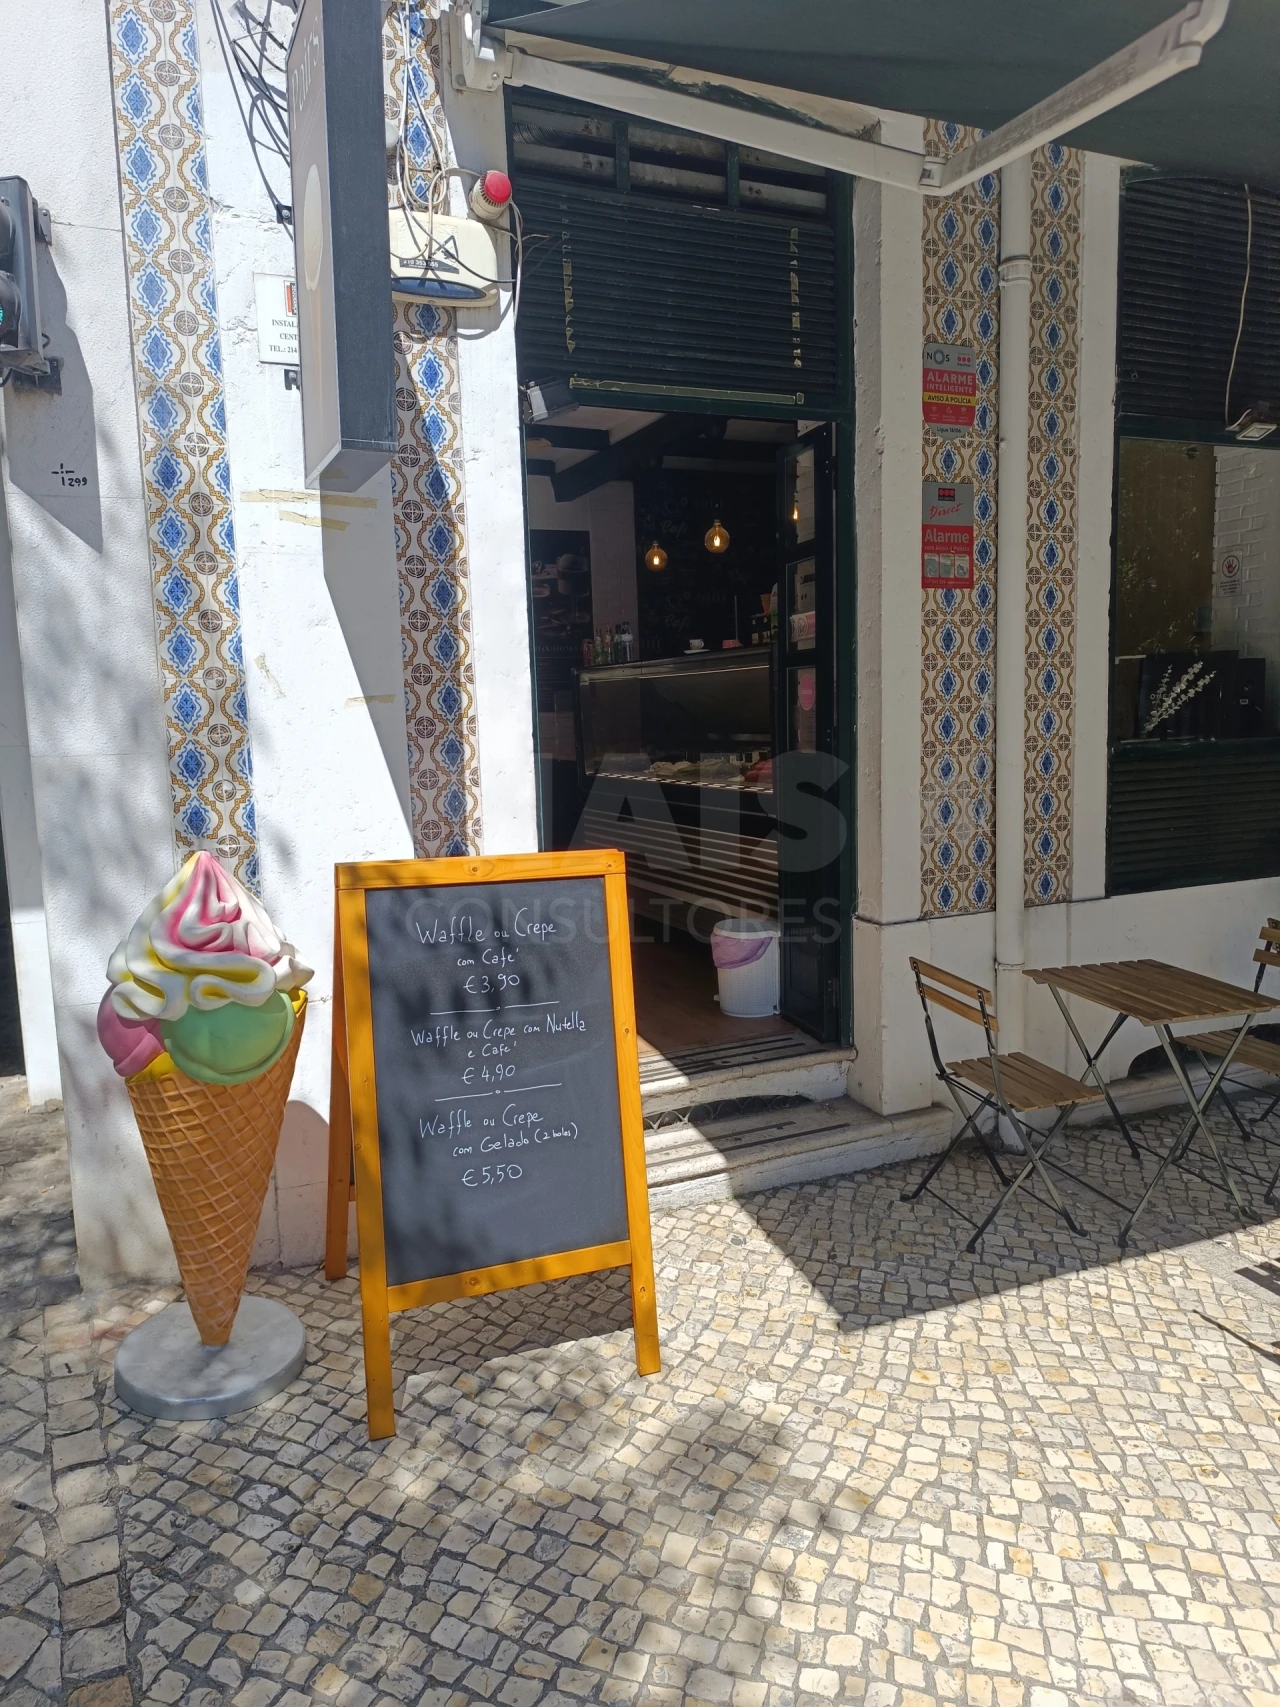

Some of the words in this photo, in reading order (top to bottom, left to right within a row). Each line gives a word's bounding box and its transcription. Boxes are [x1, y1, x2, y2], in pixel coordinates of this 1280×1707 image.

[271, 319, 299, 328] INSTAL
[926, 349, 950, 365] NOS
[926, 371, 973, 386] ALARME
[926, 383, 973, 394] INTELIGENTE
[927, 394, 945, 402] AVISO
[950, 396, 972, 405] POLÍCIA
[928, 501, 965, 519] Direct
[924, 528, 969, 544] Alarme
[416, 916, 486, 945] Waffle
[494, 930, 511, 938] ou
[514, 907, 557, 941] Crepe
[457, 958, 475, 967] com
[410, 1026, 461, 1047] Waffle
[466, 1030, 478, 1039] ou
[482, 1019, 516, 1040] Crepe
[523, 1025, 540, 1034] com
[546, 1011, 587, 1034] Nutella
[419, 1109, 473, 1140] Waffle
[483, 1118, 495, 1127] ou
[502, 1103, 544, 1128] Crepe
[452, 1146, 473, 1156] com
[480, 1130, 530, 1152] Gelado
